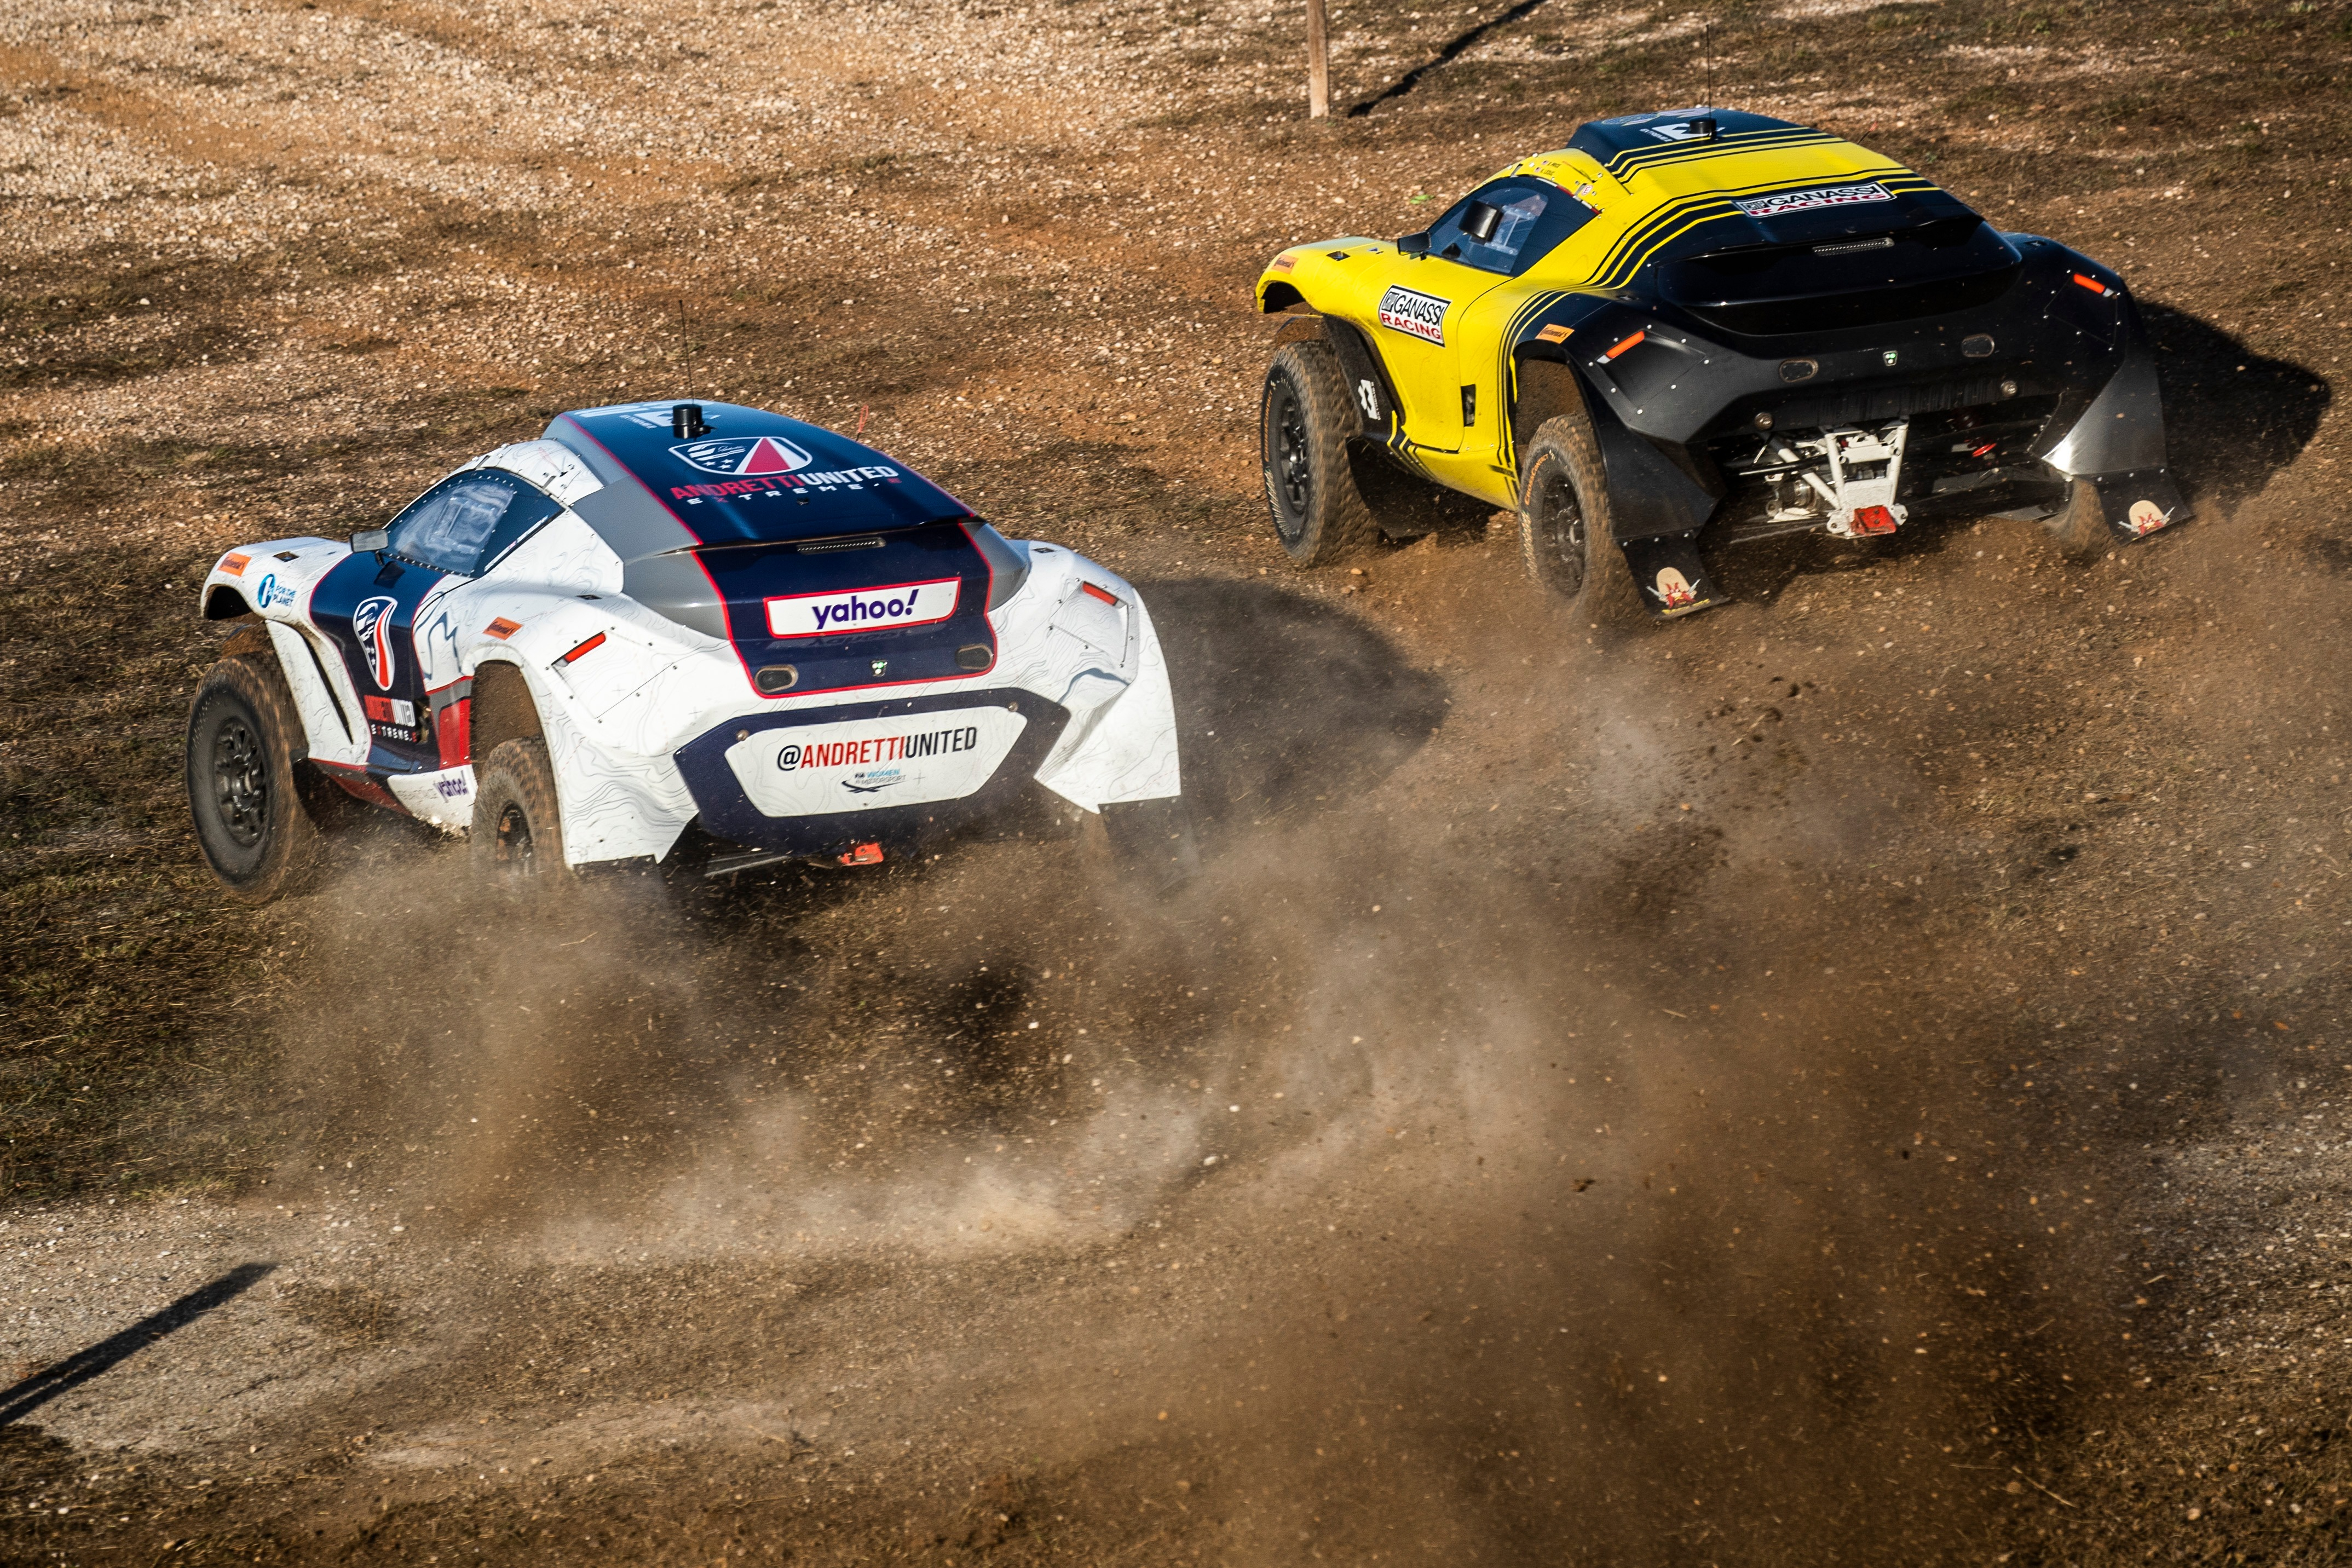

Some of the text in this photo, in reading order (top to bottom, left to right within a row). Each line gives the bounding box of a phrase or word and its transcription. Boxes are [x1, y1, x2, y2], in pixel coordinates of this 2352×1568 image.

[1748, 194, 1886, 215] RACING
[1766, 185, 1878, 206] GANASSI
[1381, 312, 1442, 340] RACING
[1393, 295, 1445, 327] GANASSI
[669, 466, 899, 500] ANDRETTIUNITED
[811, 589, 920, 630] yahoo!
[777, 727, 977, 771] @ANDRETTIUNITED
[866, 769, 901, 778] WOMEN
